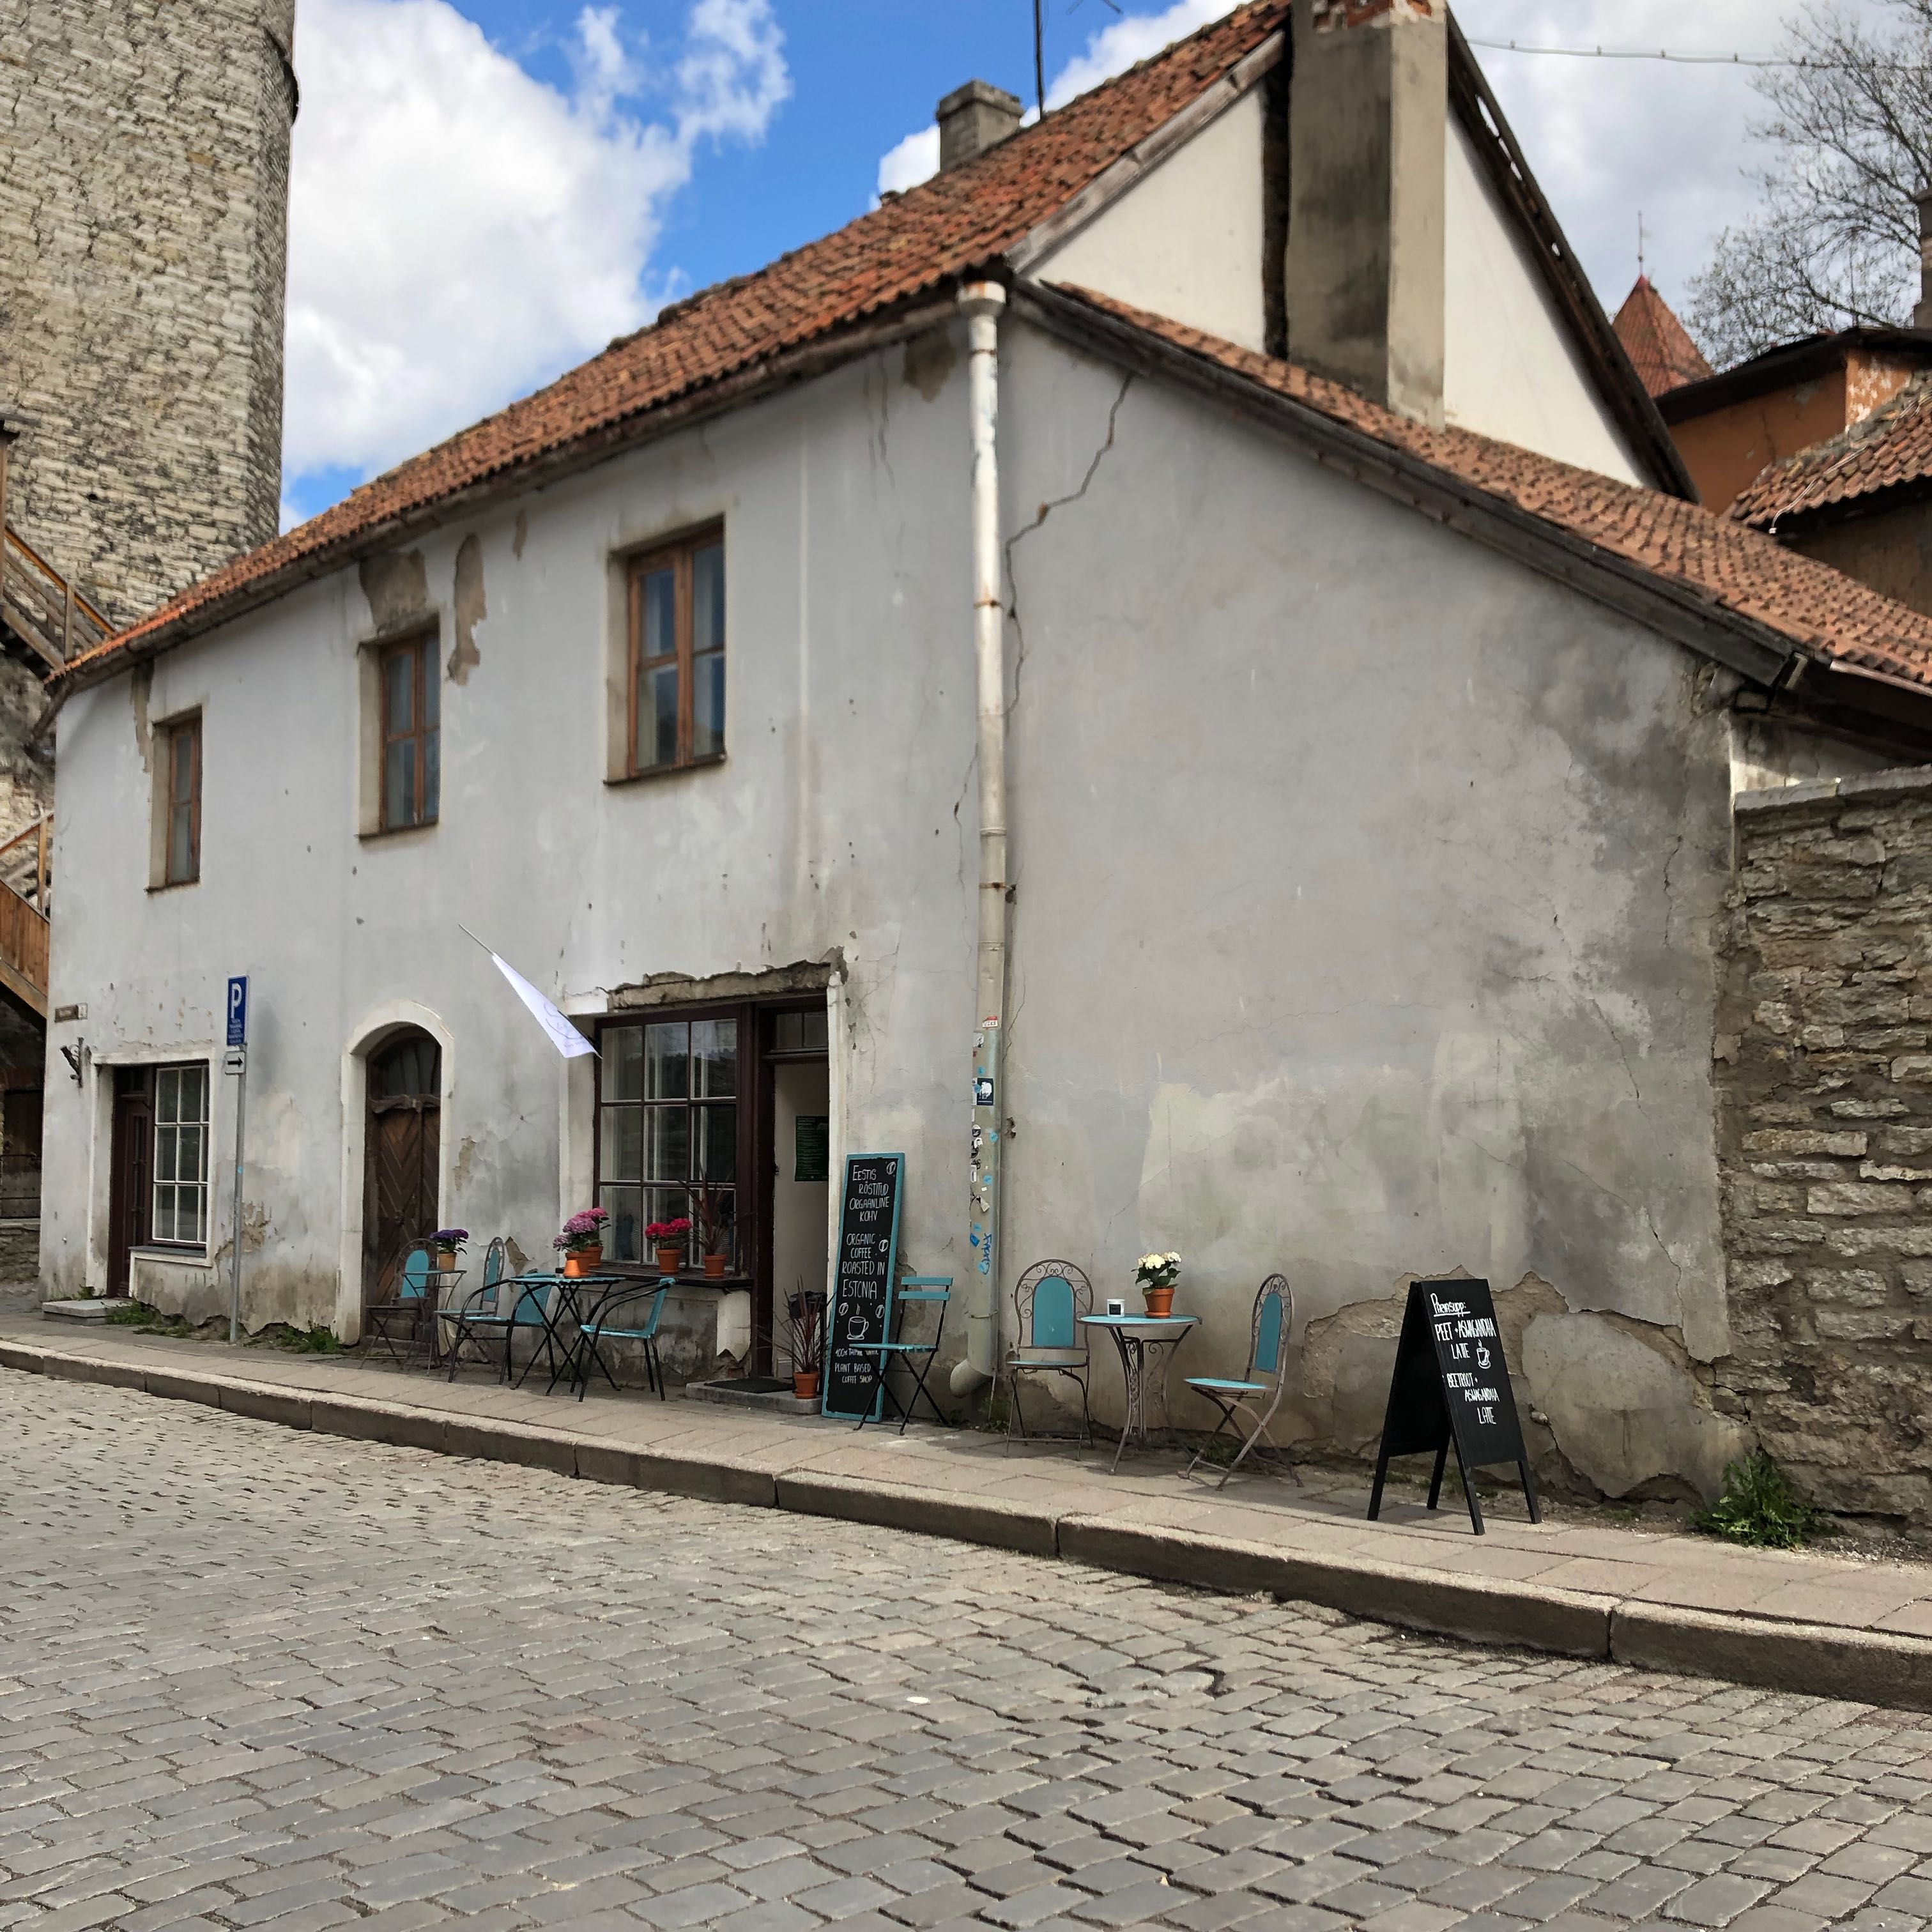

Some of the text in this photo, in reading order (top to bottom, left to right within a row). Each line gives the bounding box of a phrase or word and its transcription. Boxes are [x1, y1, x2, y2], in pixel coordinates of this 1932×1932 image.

[231, 983, 243, 1019] P
[852, 1165, 877, 1181] EESTIS
[859, 1210, 878, 1222] KOHV
[846, 1233, 876, 1246] ORGANIC
[850, 1246, 871, 1259] COFFEE
[841, 1261, 885, 1276] ROASTED IN
[842, 1278, 878, 1300] ESTONIA
[1434, 1322, 1453, 1342] PEET
[1450, 1342, 1471, 1360] LATTE
[834, 1362, 871, 1373] PLANT BASED
[841, 1375, 873, 1384] COFFEE SHOP
[1476, 1406, 1497, 1425] LATTE
